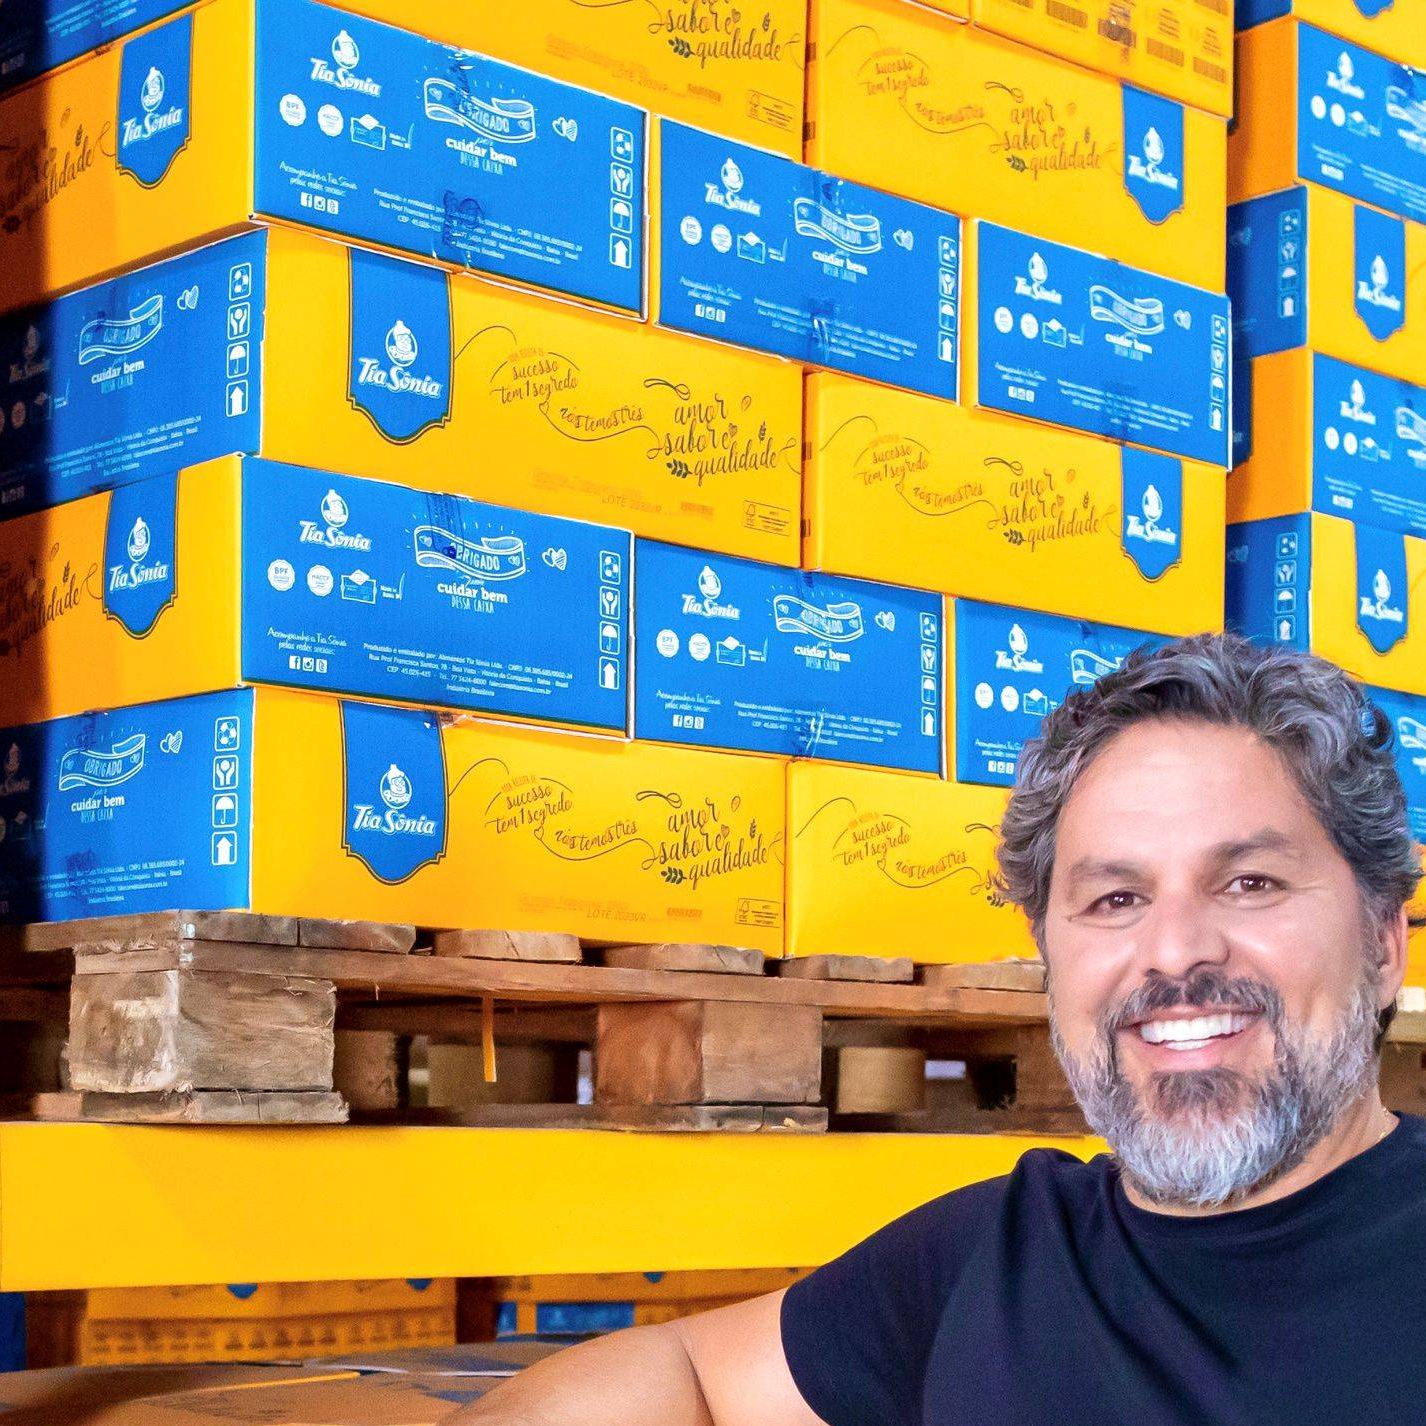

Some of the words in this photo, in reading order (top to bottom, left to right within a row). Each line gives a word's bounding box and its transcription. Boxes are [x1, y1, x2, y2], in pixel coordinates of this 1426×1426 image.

[310, 57, 335, 82] Tia
[446, 137, 487, 157] cuidar
[489, 148, 518, 167] bem
[357, 356, 387, 385] Tia
[387, 367, 442, 400] Sônia
[512, 360, 559, 380] sucesso
[675, 392, 726, 425] amor
[694, 437, 778, 487] qualidade
[299, 520, 323, 543] Tia
[323, 527, 371, 552] Sônia
[437, 583, 477, 599] cuidar
[481, 589, 508, 604] bem
[352, 803, 384, 832] Tia
[384, 808, 437, 836] Sônia
